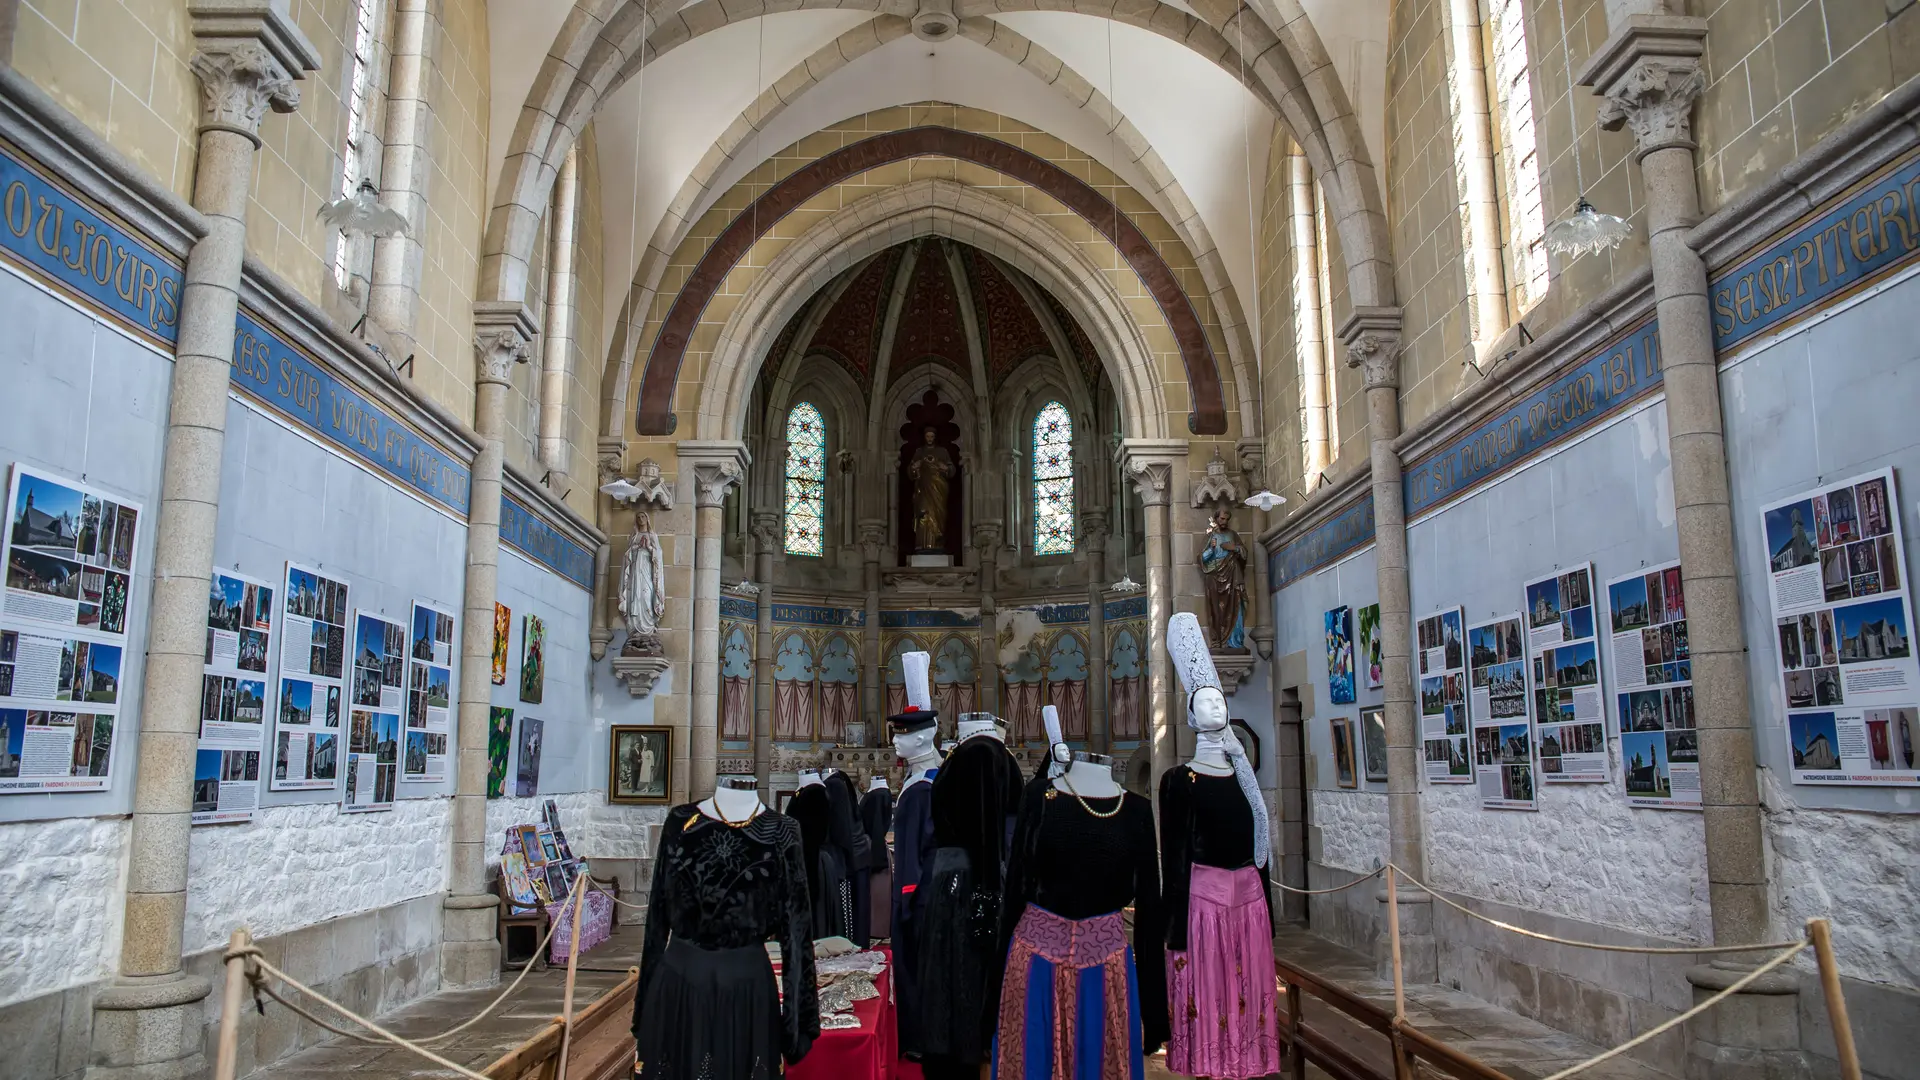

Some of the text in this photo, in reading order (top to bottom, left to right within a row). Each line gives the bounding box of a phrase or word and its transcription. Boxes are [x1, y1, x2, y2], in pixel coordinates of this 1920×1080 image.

[4, 180, 178, 331] OUJOURS
[277, 357, 321, 427] SUR
[331, 390, 378, 452] VOUS
[410, 445, 439, 487] QUE
[1433, 453, 1456, 493] SIT
[1461, 415, 1523, 479] NOMEN
[1528, 372, 1595, 441] MEUM
[1601, 344, 1637, 400] IBI
